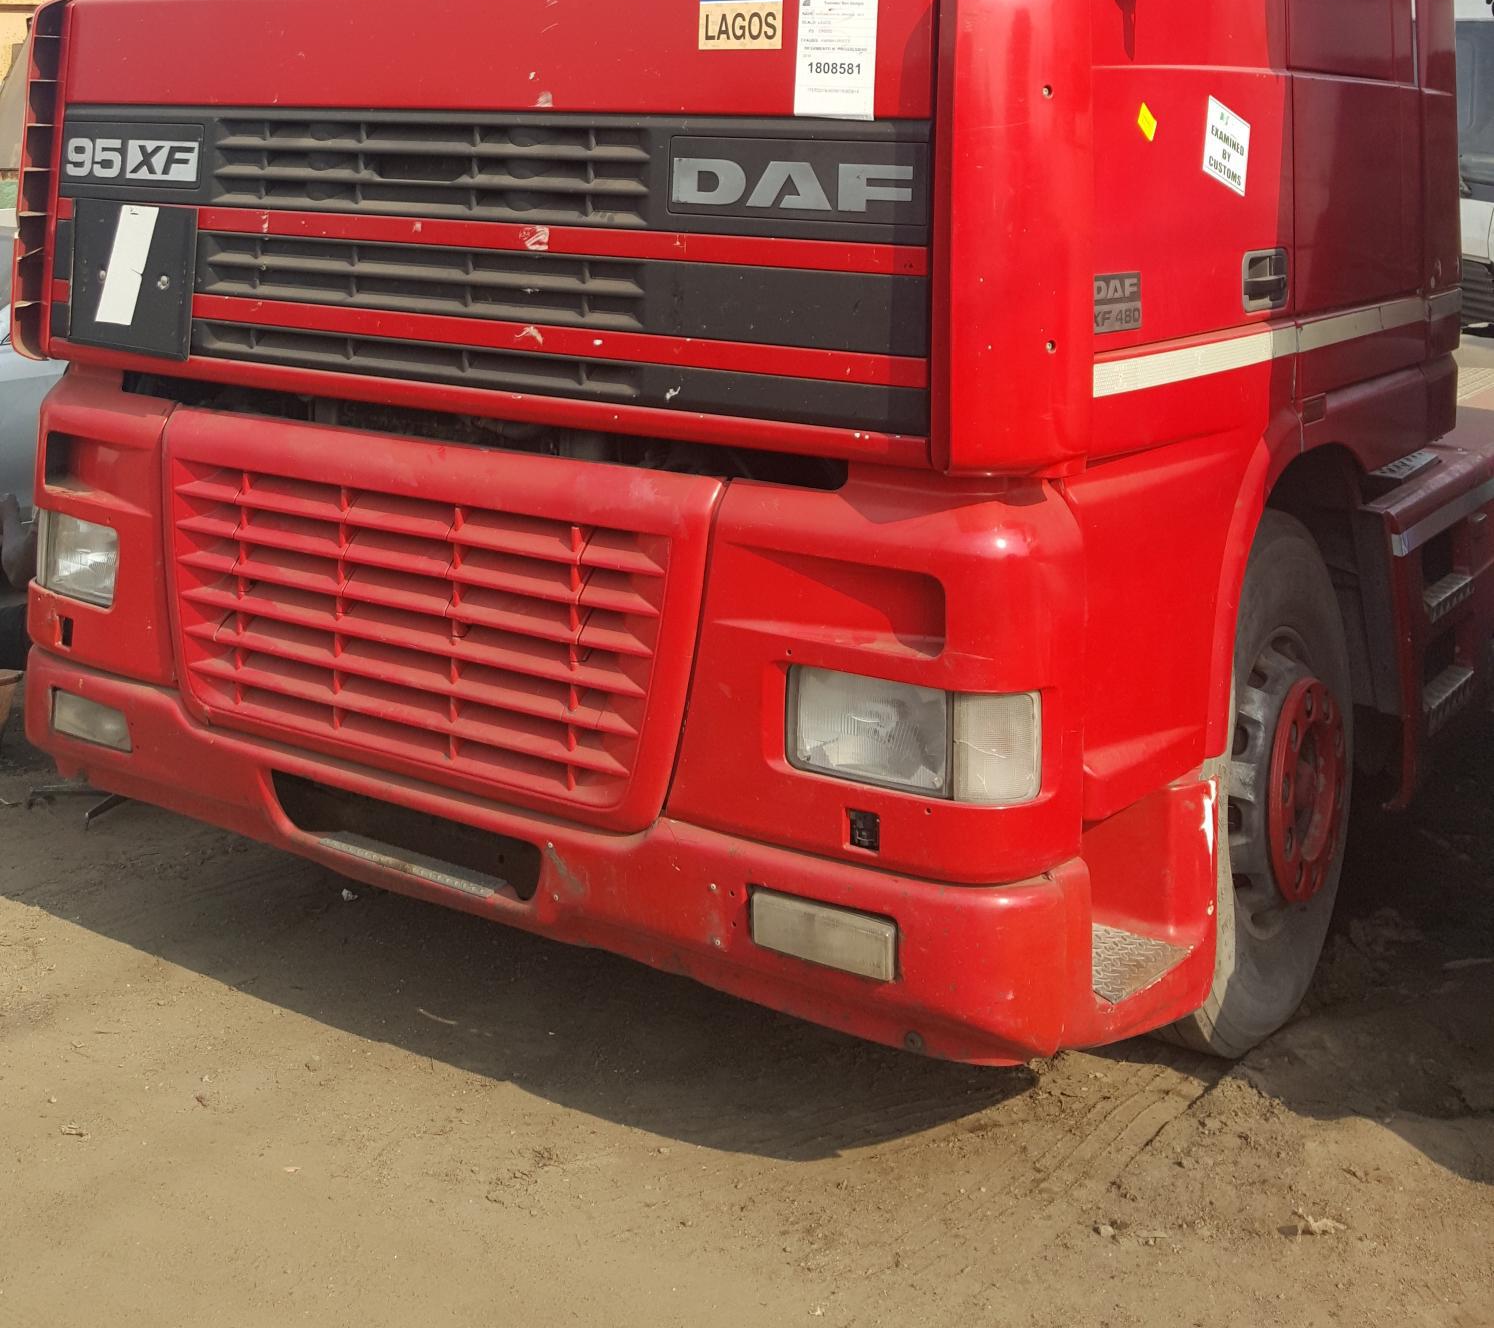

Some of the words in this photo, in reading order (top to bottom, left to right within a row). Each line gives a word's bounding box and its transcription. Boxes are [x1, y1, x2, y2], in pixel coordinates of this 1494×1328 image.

[705, 12, 777, 40] LAGOS
[808, 61, 861, 75] 1808581
[1210, 124, 1245, 157] EXAMINED
[1222, 148, 1231, 163] BY
[1208, 155, 1242, 186] CUSTOMS
[672, 157, 914, 212] DAF
[1094, 277, 1138, 300] DAF
[1115, 307, 1141, 325] 480
